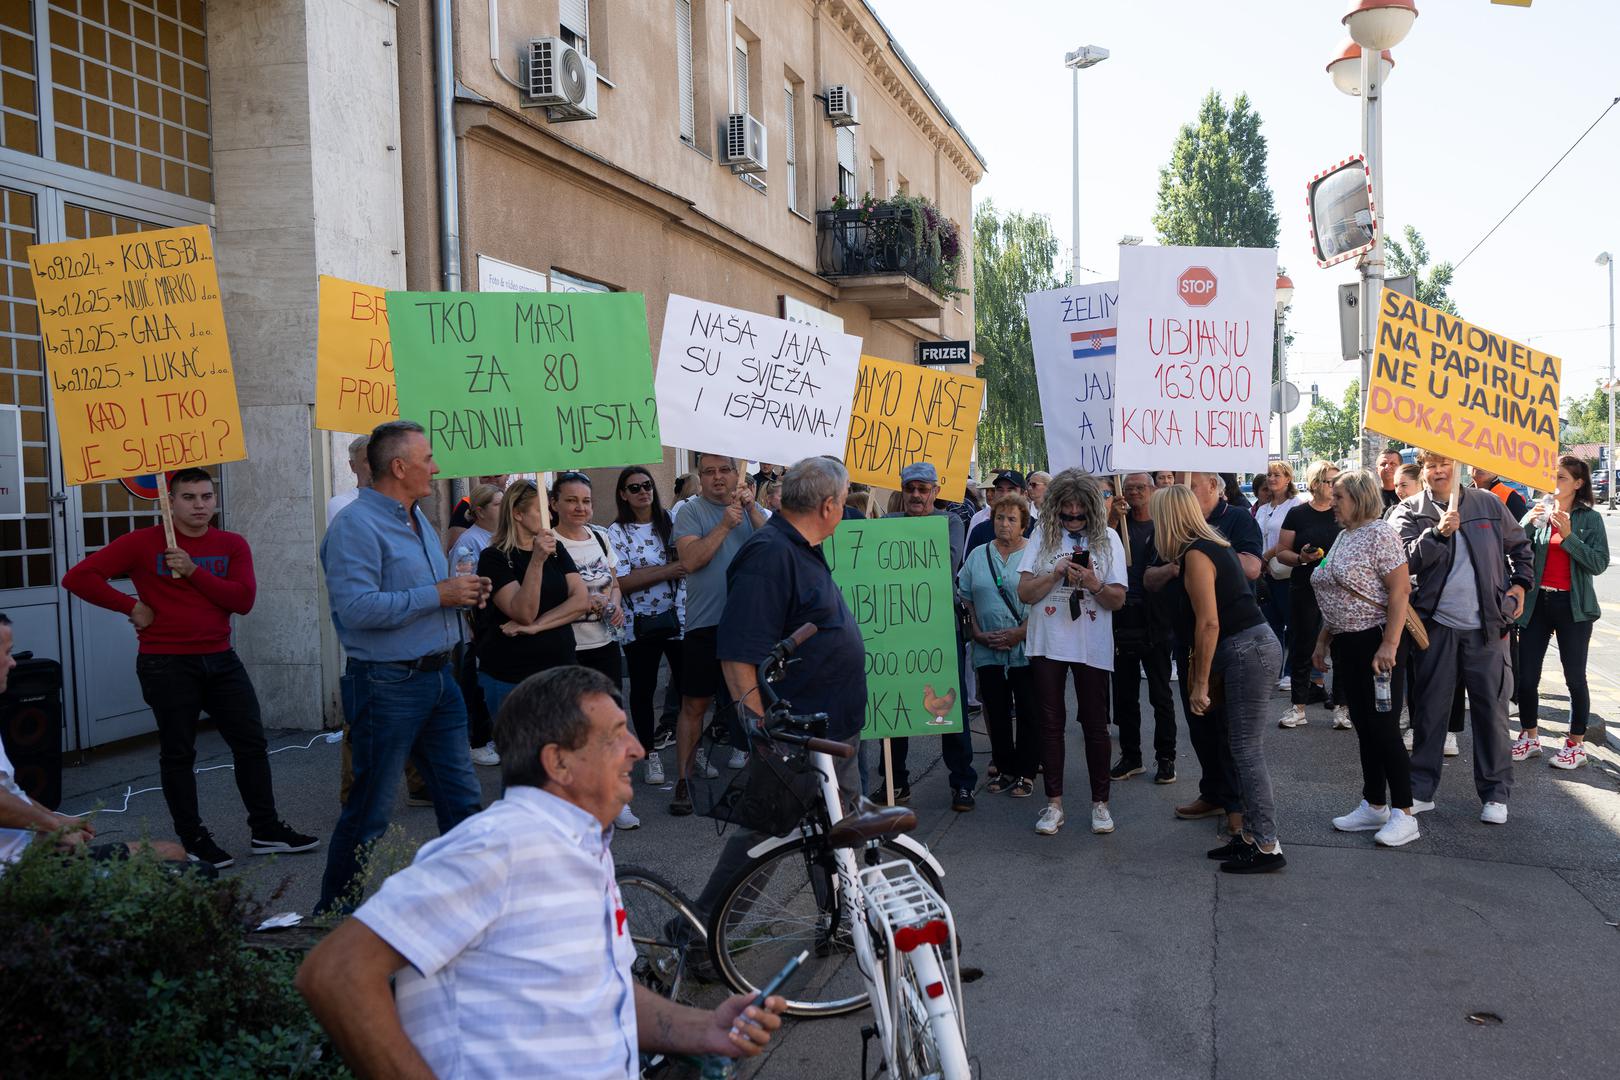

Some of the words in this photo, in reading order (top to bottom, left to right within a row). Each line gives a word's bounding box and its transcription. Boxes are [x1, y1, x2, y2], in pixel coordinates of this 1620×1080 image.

[121, 237, 198, 272] KONES-BI
[154, 273, 196, 307] MARKO
[1181, 279, 1214, 294] STOP
[131, 313, 181, 344] GALA
[415, 301, 476, 344] TKO
[515, 303, 575, 344] MARI
[690, 310, 758, 349] NAŠA
[772, 330, 831, 366] JAJA
[1149, 318, 1249, 366] UBIJANJU
[1380, 321, 1421, 359] NA
[1382, 292, 1559, 383] SALMONELA
[143, 346, 207, 382] LUKAČ
[465, 355, 511, 392] ZA
[543, 353, 579, 391] 80
[681, 346, 721, 375] SU
[736, 357, 821, 398] SVJEŽA
[922, 347, 966, 361] FRIZER
[911, 375, 974, 431] NAŠE
[1075, 372, 1116, 402] JAJ
[1154, 363, 1251, 403] 163.000
[1376, 353, 1418, 390] NE
[1428, 370, 1449, 399] U
[1458, 382, 1556, 442] JAJIMA
[86, 402, 126, 434] KAD
[140, 398, 149, 426] I
[156, 390, 207, 423] TKO
[429, 407, 523, 451] RADNIH
[556, 398, 657, 453] MJESTA?
[694, 386, 704, 412] I
[723, 391, 842, 438] ISPRAVNA!
[1078, 411, 1096, 440] A
[1122, 408, 1183, 446] KOKA
[1195, 410, 1265, 449] NESILICA
[1371, 385, 1558, 480] DOKAZANO!!
[76, 445, 106, 482] JE
[847, 530, 863, 569] 7
[877, 539, 941, 570] GODINA
